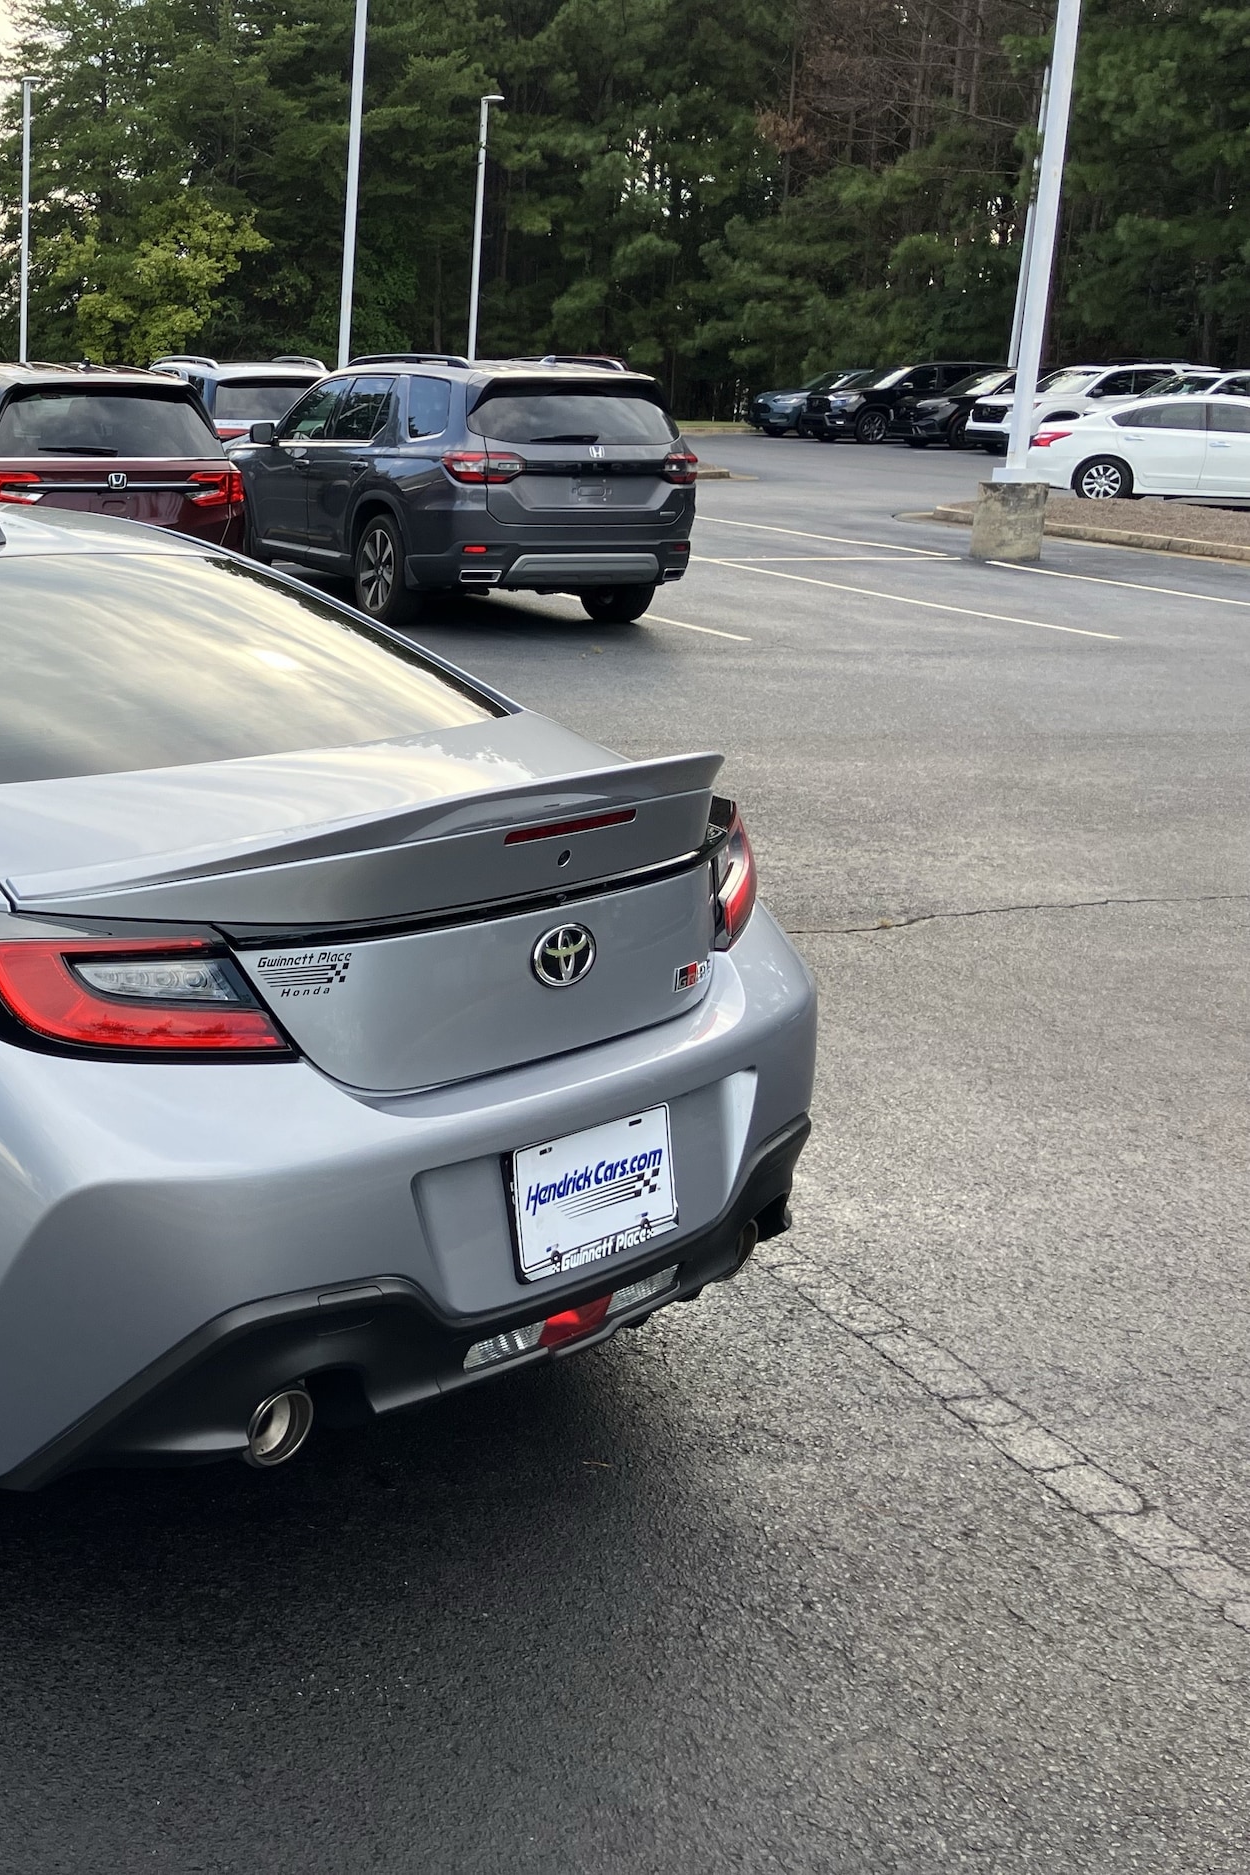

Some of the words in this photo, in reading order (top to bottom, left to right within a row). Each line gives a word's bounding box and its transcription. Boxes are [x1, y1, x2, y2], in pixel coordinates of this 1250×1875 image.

[257, 953, 314, 968] Gwinnett
[317, 951, 352, 964] Place
[281, 986, 330, 997] Honda
[561, 1236, 615, 1272] Gwinnett
[615, 1227, 647, 1253] Place
